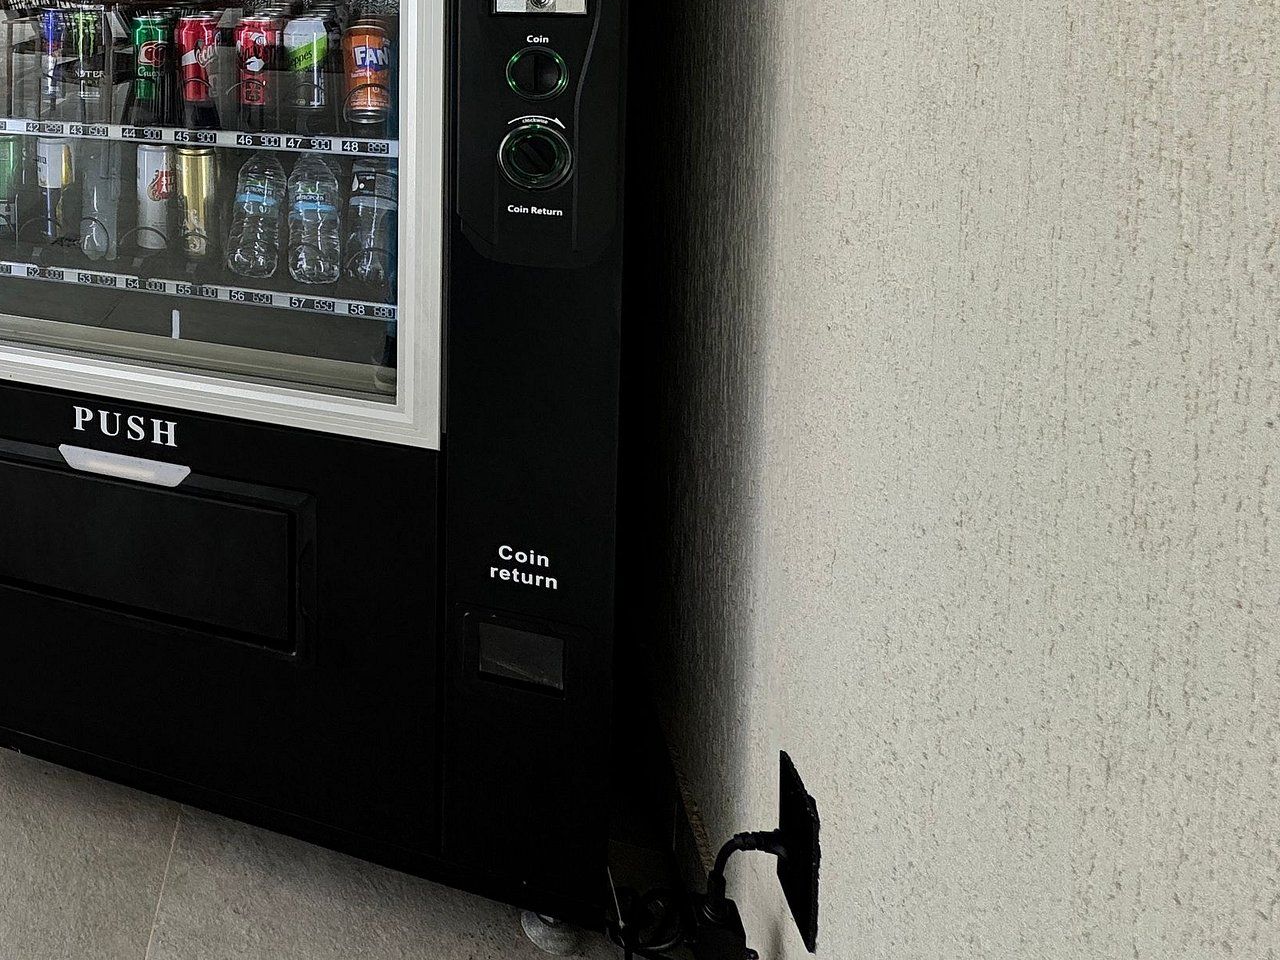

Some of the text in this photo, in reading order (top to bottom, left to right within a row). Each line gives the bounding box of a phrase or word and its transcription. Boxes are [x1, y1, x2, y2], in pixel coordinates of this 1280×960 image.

[526, 34, 549, 43] Coin
[522, 117, 549, 125] clockwise
[27, 122, 40, 132] 42
[70, 125, 83, 135] 43
[122, 128, 136, 138] 44
[176, 132, 190, 142] 45
[238, 136, 253, 146] 46
[287, 138, 302, 148] 47
[343, 141, 359, 152] 48
[507, 204, 563, 216] Coin Return
[28, 268, 40, 276] 52
[79, 274, 92, 284] 53
[128, 279, 139, 288] 54
[177, 285, 192, 295] 55
[231, 290, 245, 301] 56
[291, 297, 306, 308] 57
[350, 304, 366, 315] 58
[73, 405, 177, 447] PUSH
[498, 545, 549, 567] Coin
[490, 566, 557, 589] return
